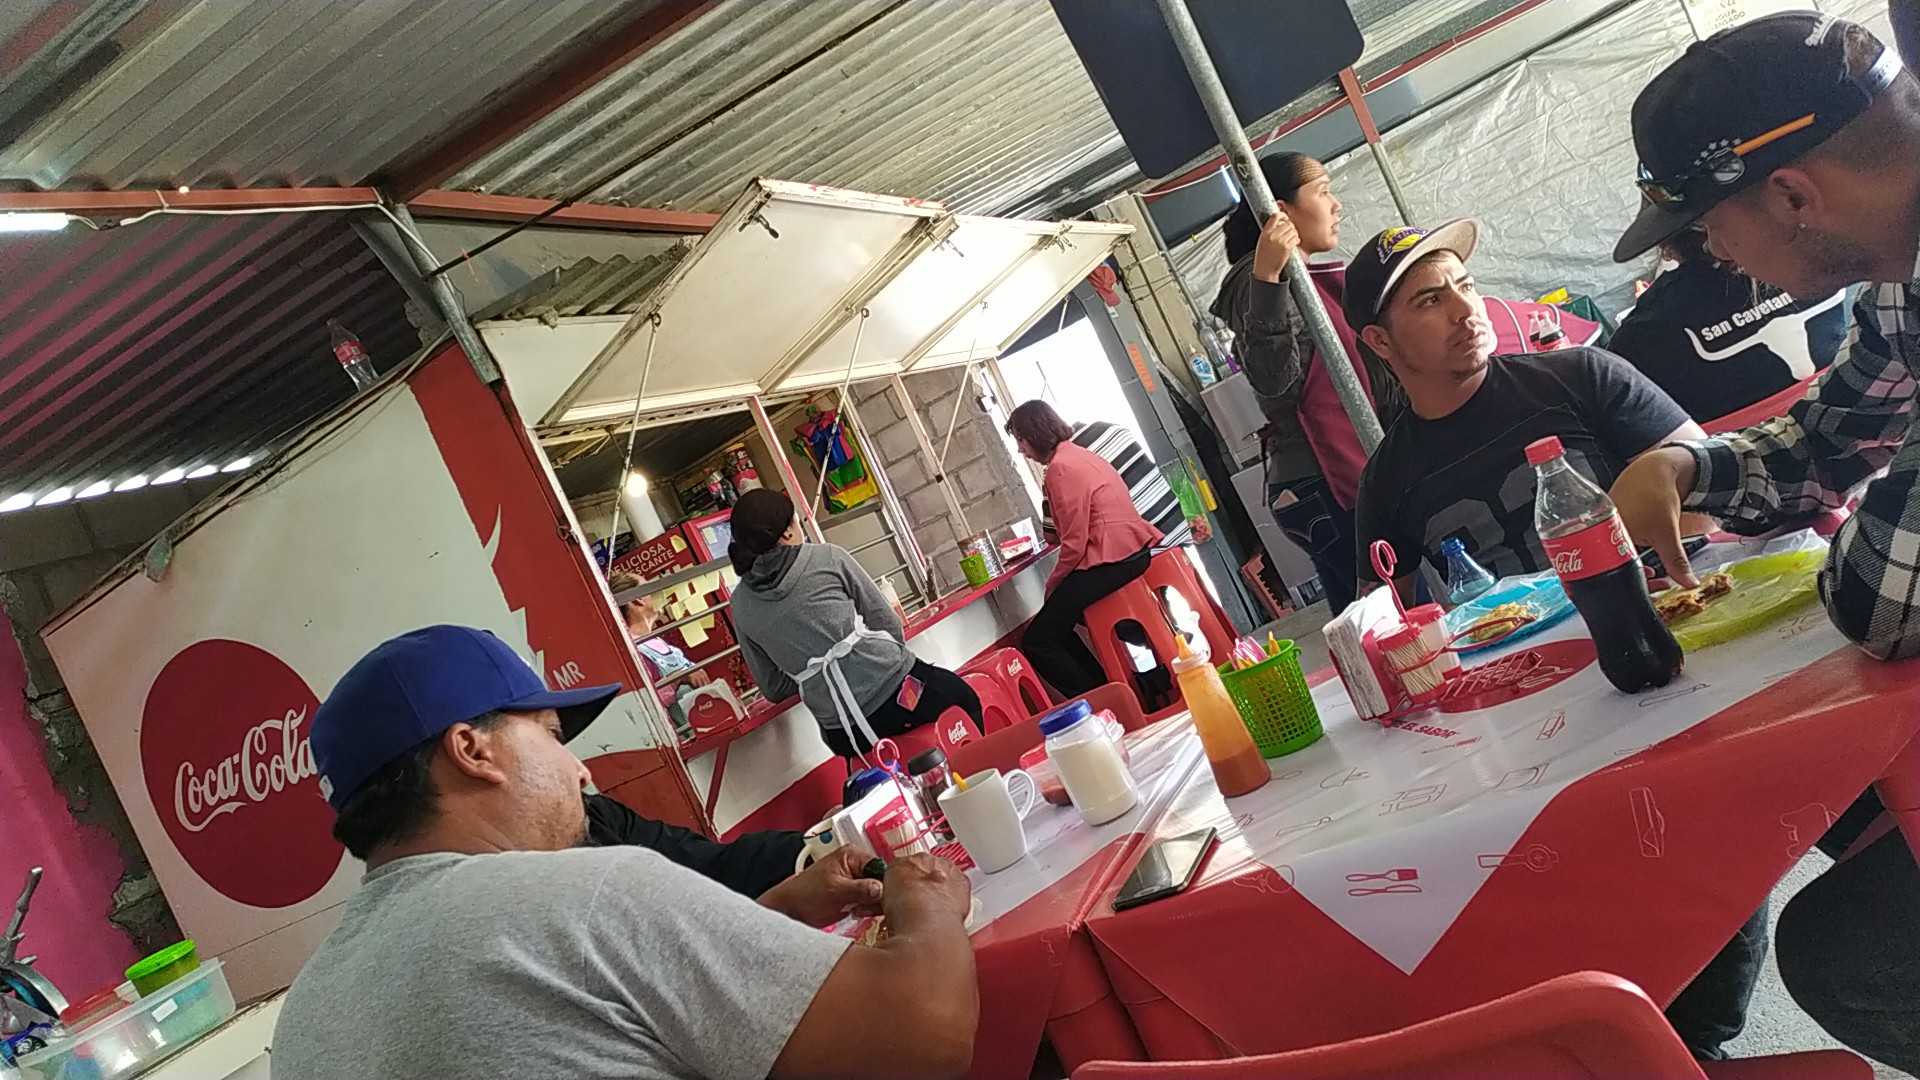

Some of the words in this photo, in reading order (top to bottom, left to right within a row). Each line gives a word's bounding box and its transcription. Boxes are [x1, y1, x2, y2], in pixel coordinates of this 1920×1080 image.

[1701, 320, 1733, 342] San
[1731, 292, 1794, 327] Cayetan
[630, 549, 675, 577] ESCANTE
[1555, 548, 1583, 574] Cola
[552, 661, 586, 691] MR
[1414, 725, 1457, 740] SABOR
[174, 703, 319, 832] Coca-Cola
